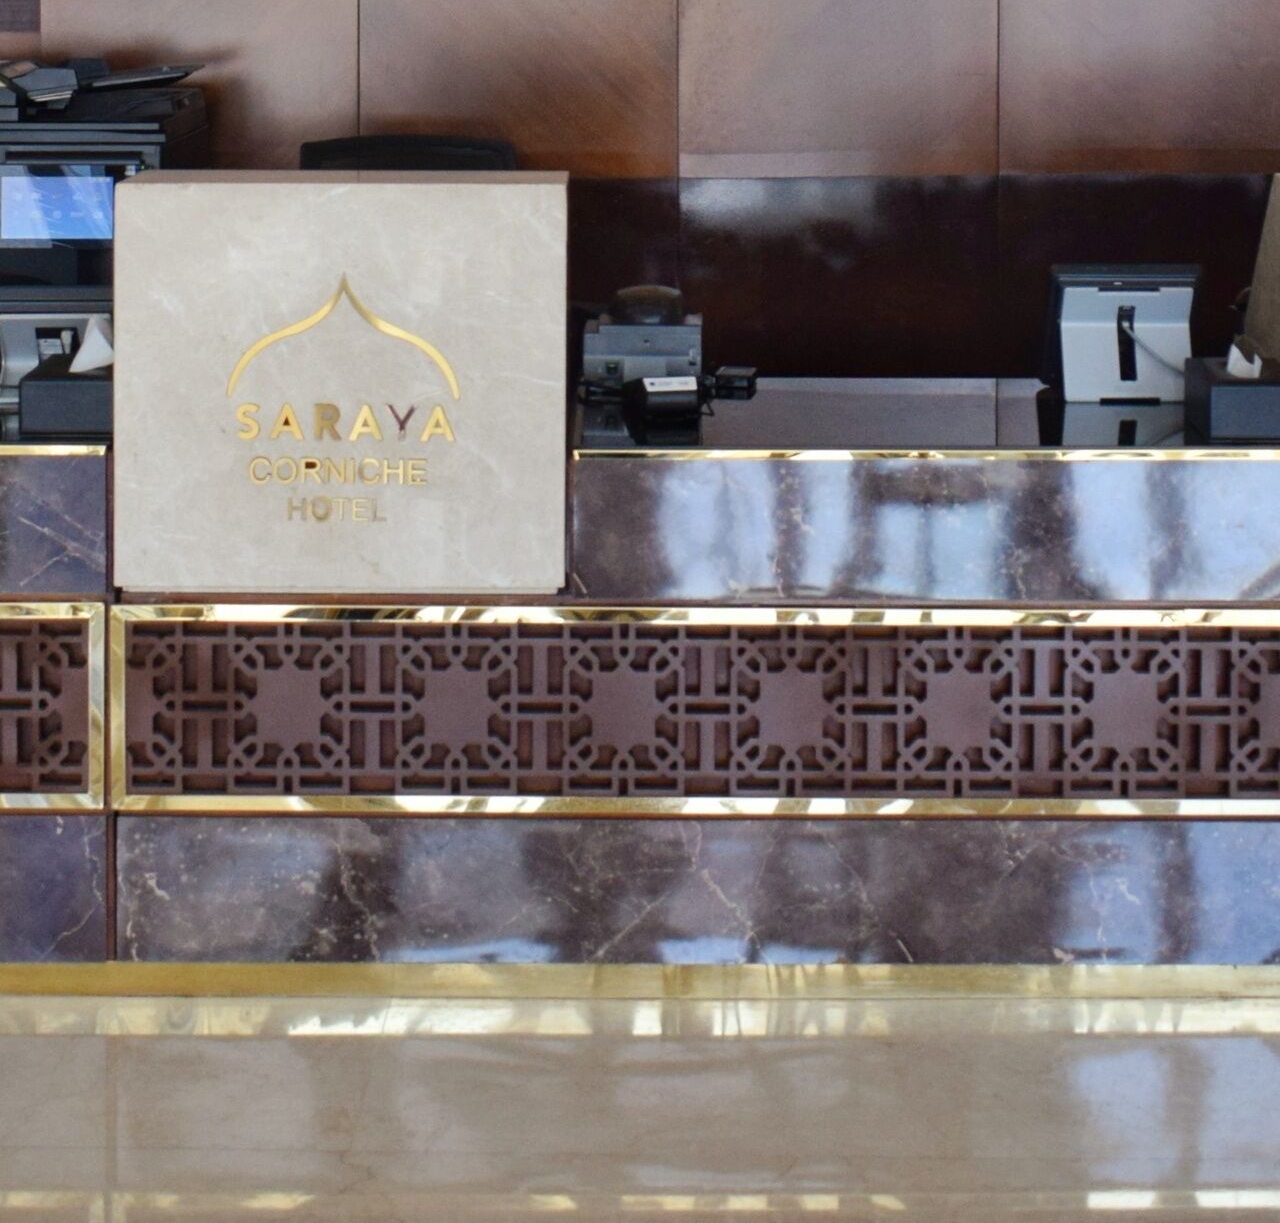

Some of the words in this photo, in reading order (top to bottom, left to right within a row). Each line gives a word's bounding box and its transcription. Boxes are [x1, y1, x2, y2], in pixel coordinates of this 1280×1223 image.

[236, 402, 455, 442] SARAYA
[249, 456, 428, 486] CORNICHE
[286, 497, 388, 522] HOTEL
